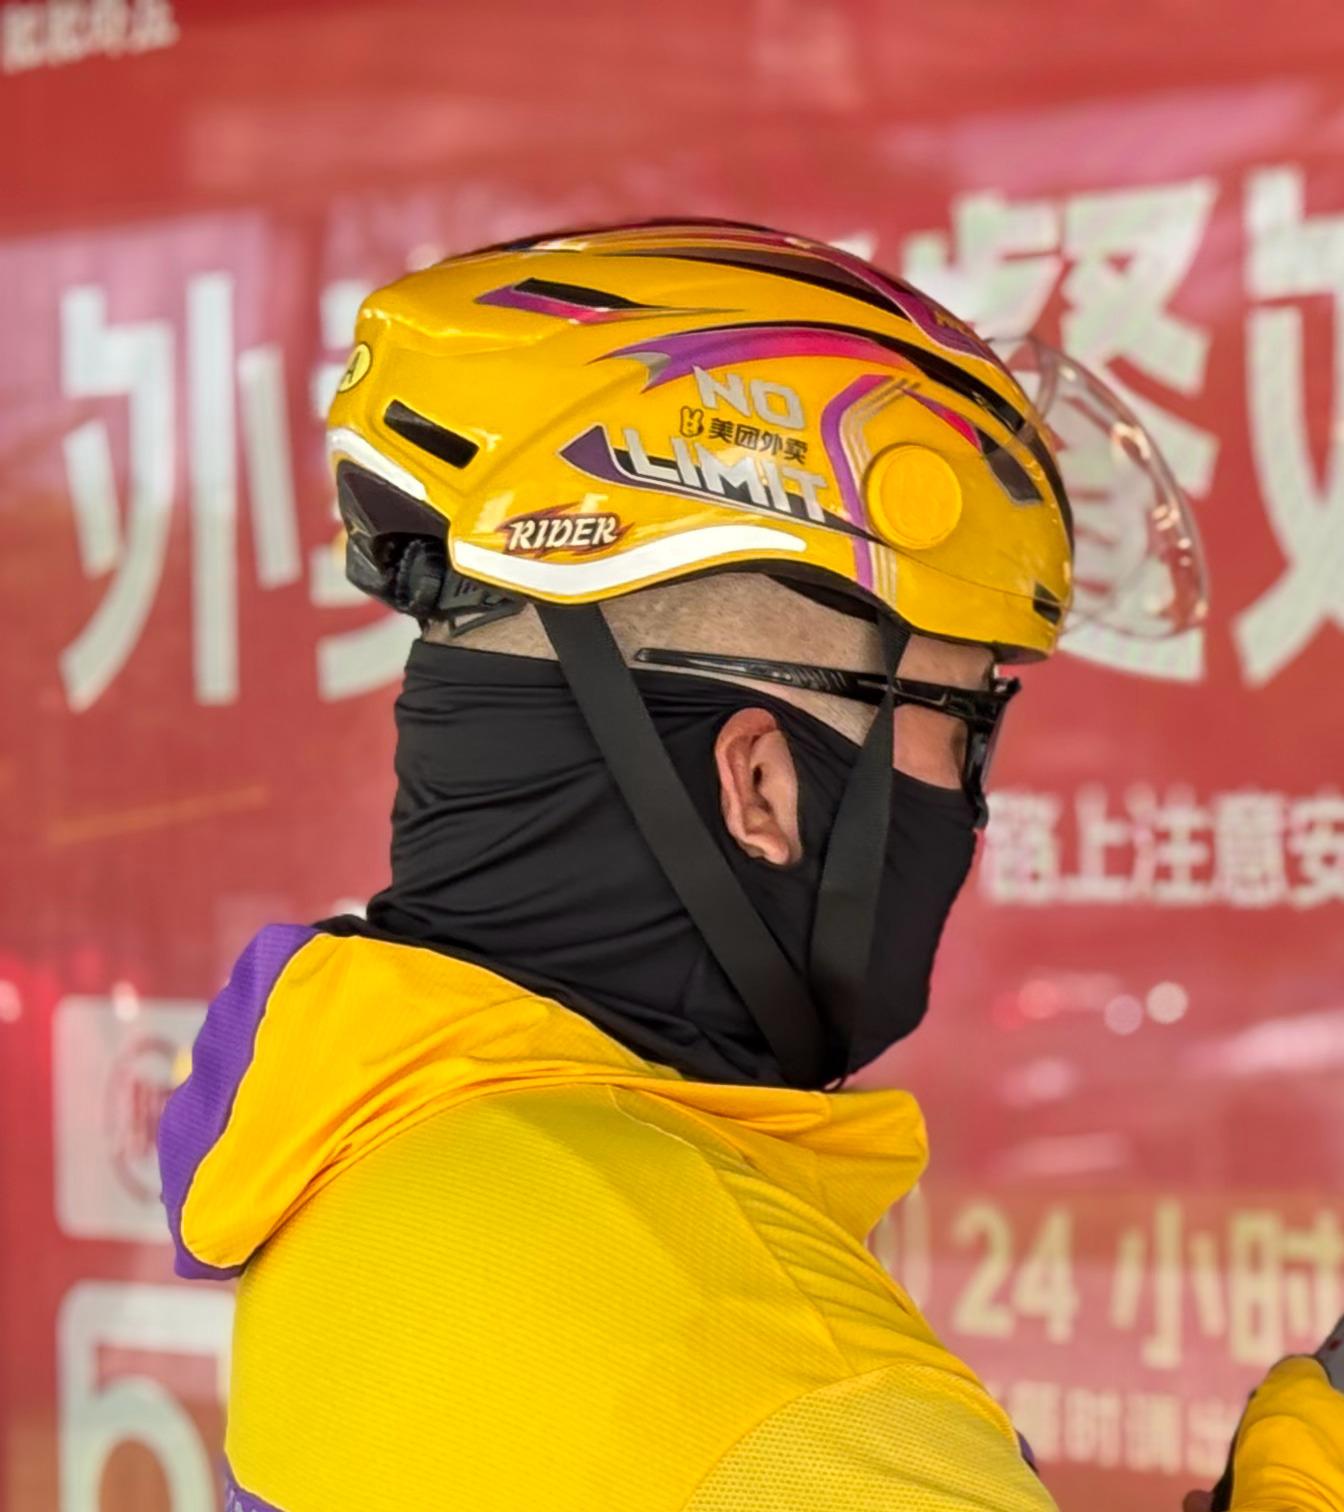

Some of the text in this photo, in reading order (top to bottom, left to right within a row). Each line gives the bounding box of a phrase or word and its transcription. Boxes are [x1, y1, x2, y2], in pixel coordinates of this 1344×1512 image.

[693, 365, 806, 430] NO
[708, 417, 808, 465] 美团外卖
[623, 430, 828, 523] LIMIT
[508, 516, 618, 551] RIDER
[952, 1196, 1081, 1344] 24
